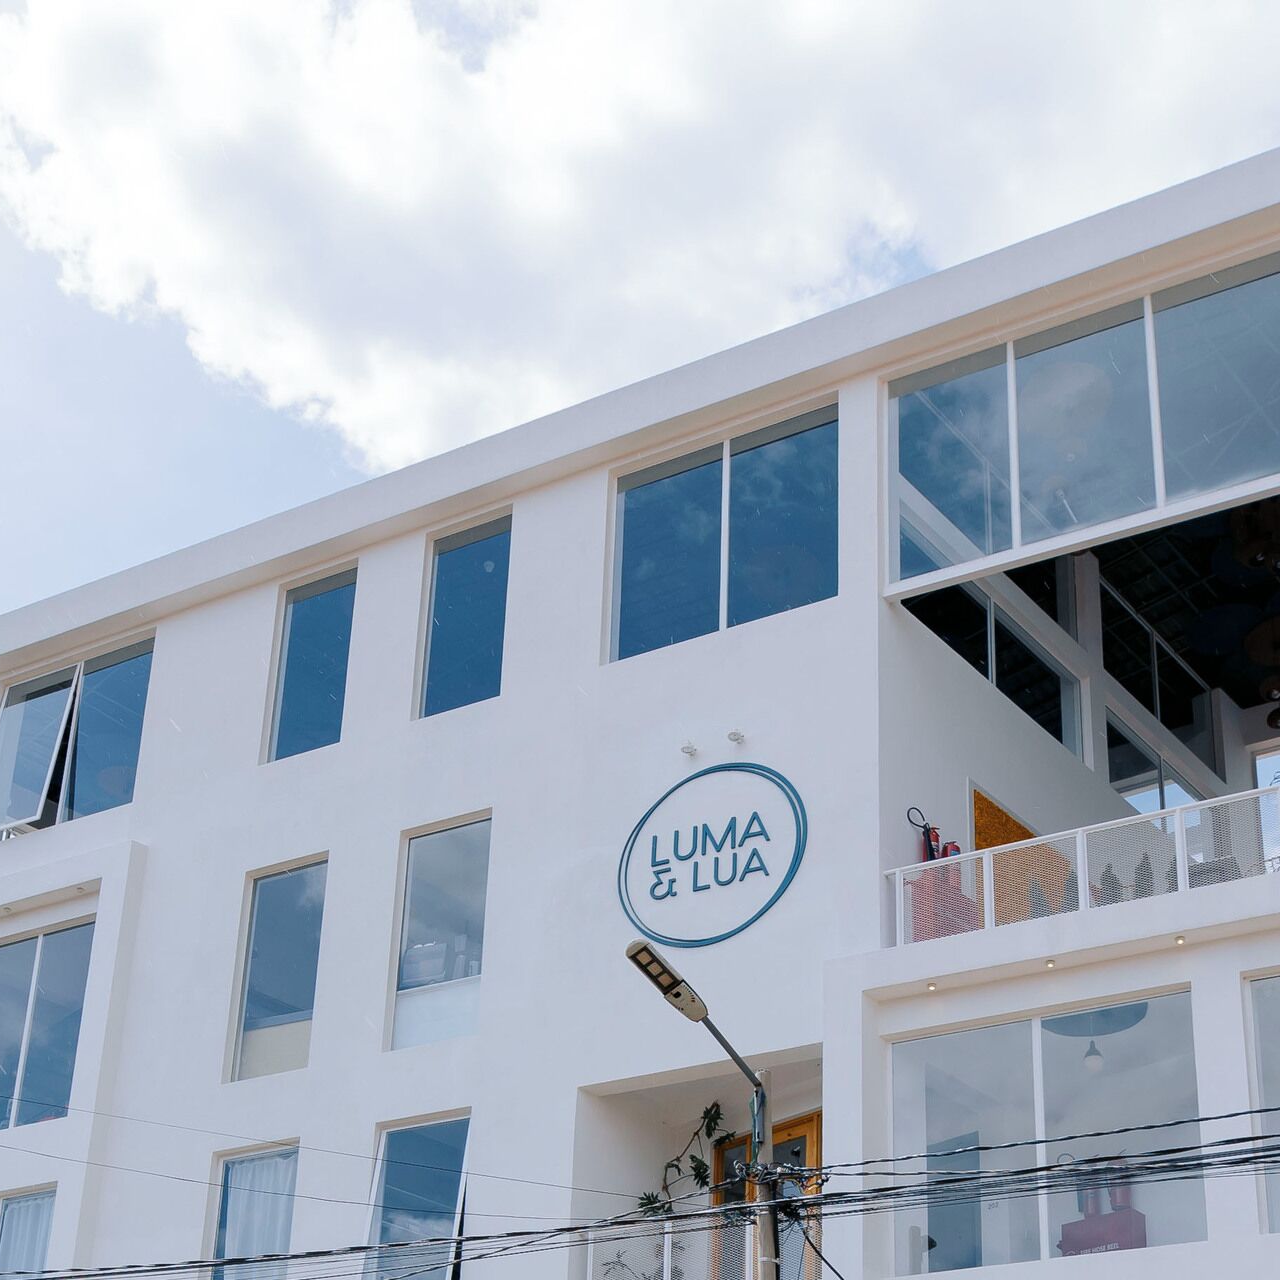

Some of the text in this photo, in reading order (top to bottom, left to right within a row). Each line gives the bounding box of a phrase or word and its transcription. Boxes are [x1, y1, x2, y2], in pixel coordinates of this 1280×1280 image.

[651, 811, 771, 868] LUMA
[649, 847, 770, 901] & LUA
